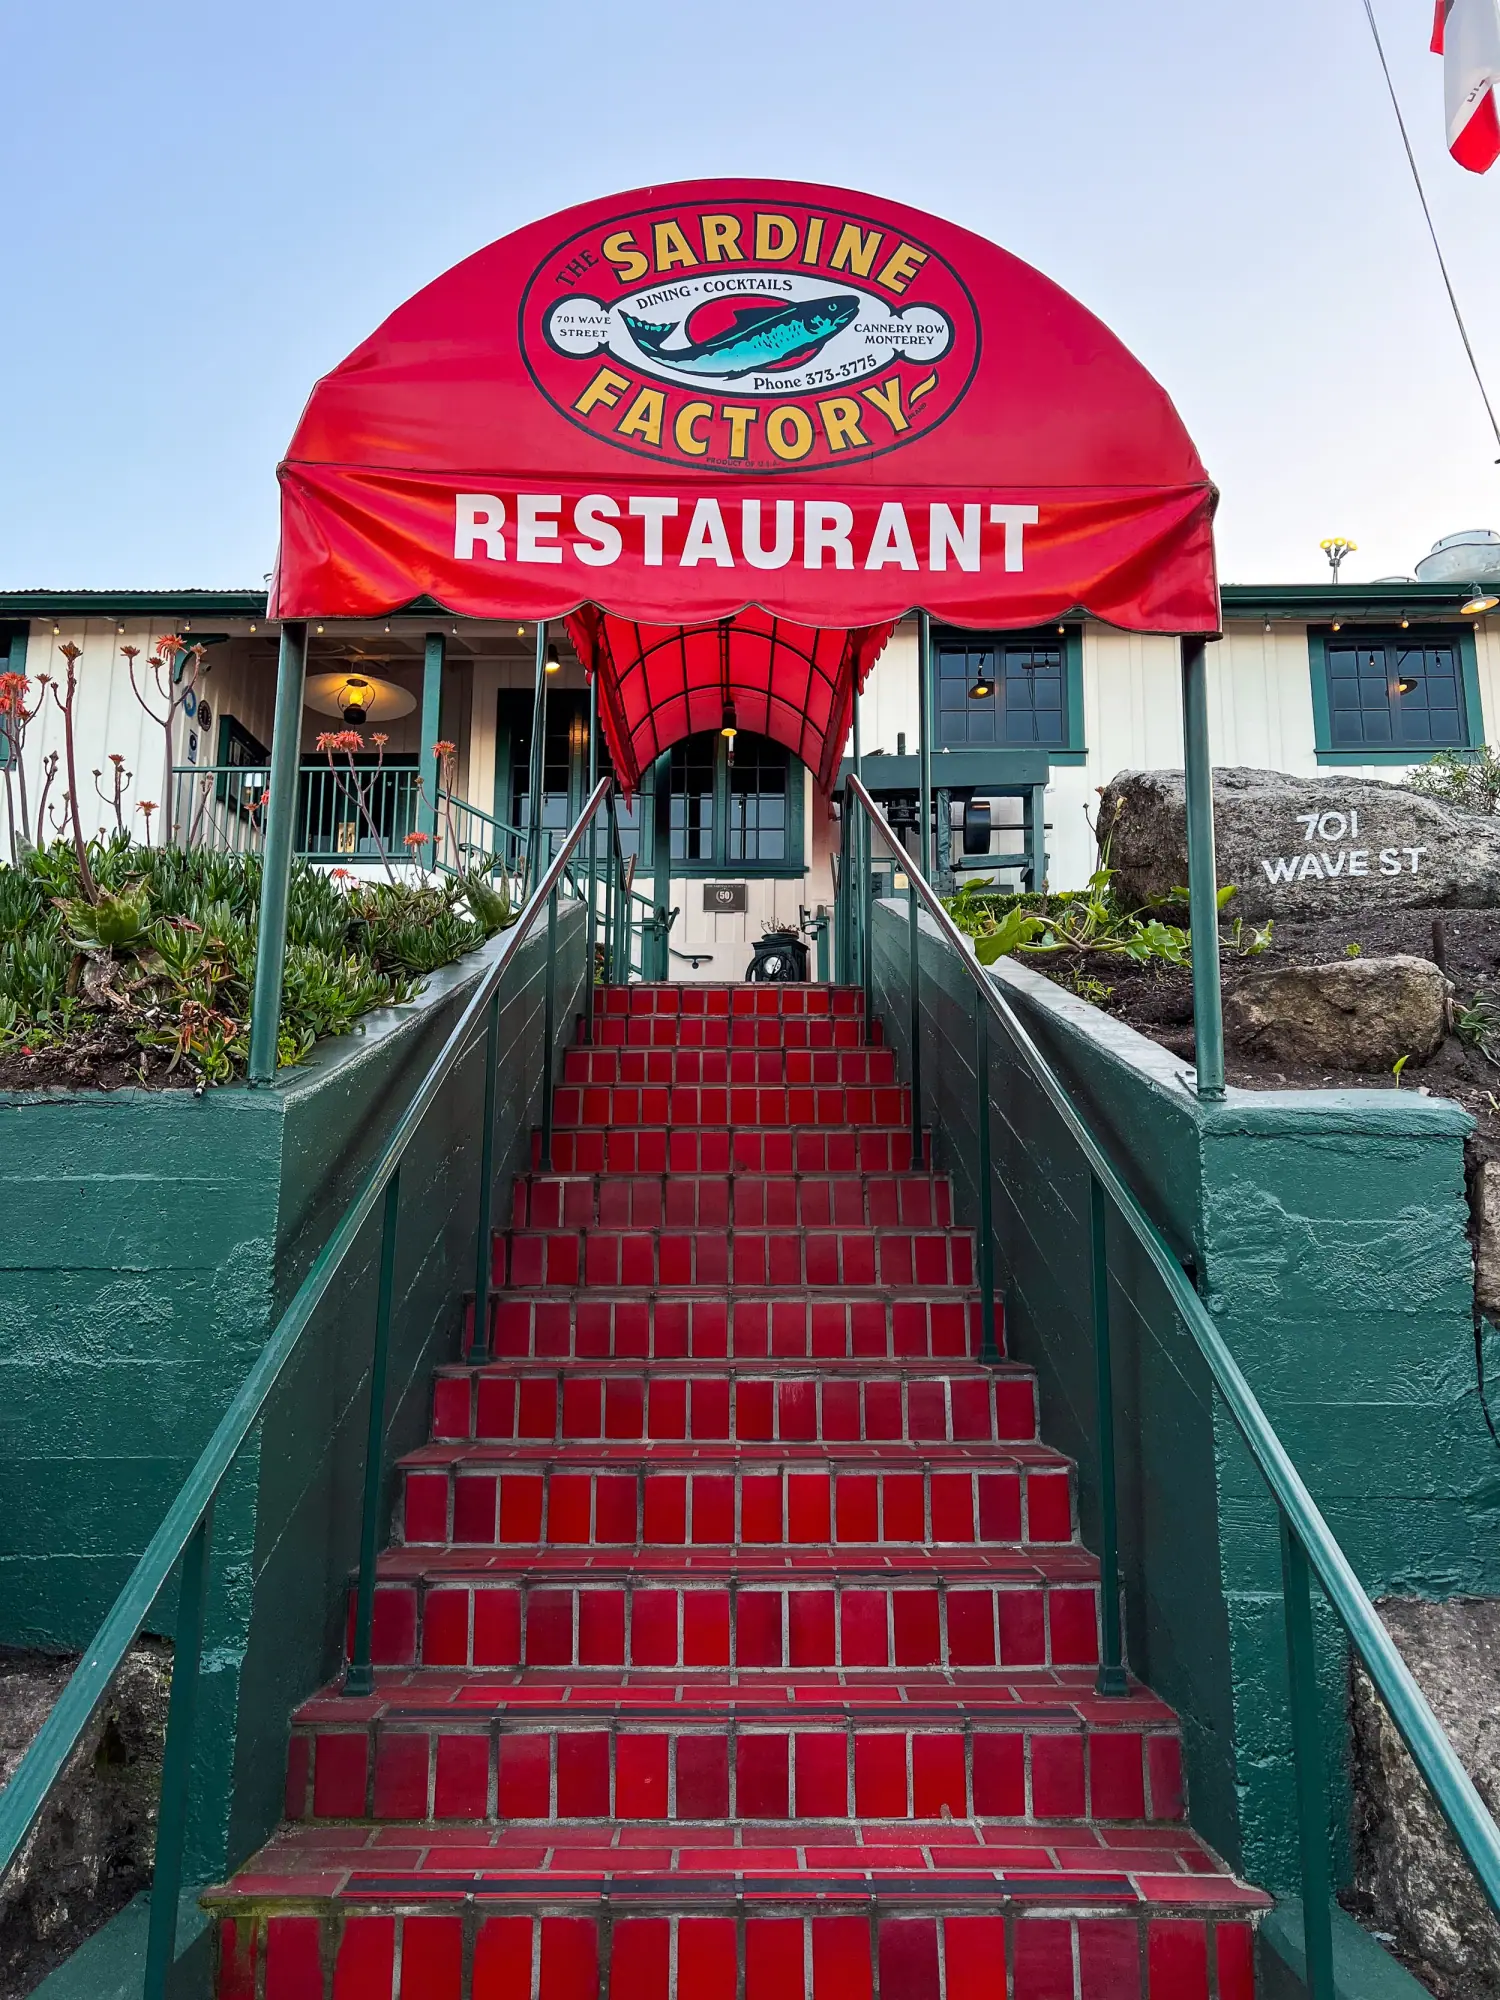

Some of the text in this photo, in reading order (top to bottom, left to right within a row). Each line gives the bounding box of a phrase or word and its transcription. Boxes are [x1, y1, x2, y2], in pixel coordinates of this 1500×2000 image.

[555, 213, 931, 296] THE SARDINE
[636, 278, 793, 310] DINING COCKTAILS
[559, 329, 609, 337] STREET
[578, 316, 612, 325] WAVE
[854, 323, 945, 334] CANNERY ROW
[864, 335, 935, 345] MONTEREY
[753, 354, 877, 390] Phone 373-3775
[572, 364, 911, 460] FACTORY
[706, 457, 741, 466] PRODUCT
[453, 492, 1039, 573] RESTAURANT
[1296, 810, 1359, 841] 701
[1261, 847, 1427, 885] WAVE ST
[719, 891, 730, 900] 50
